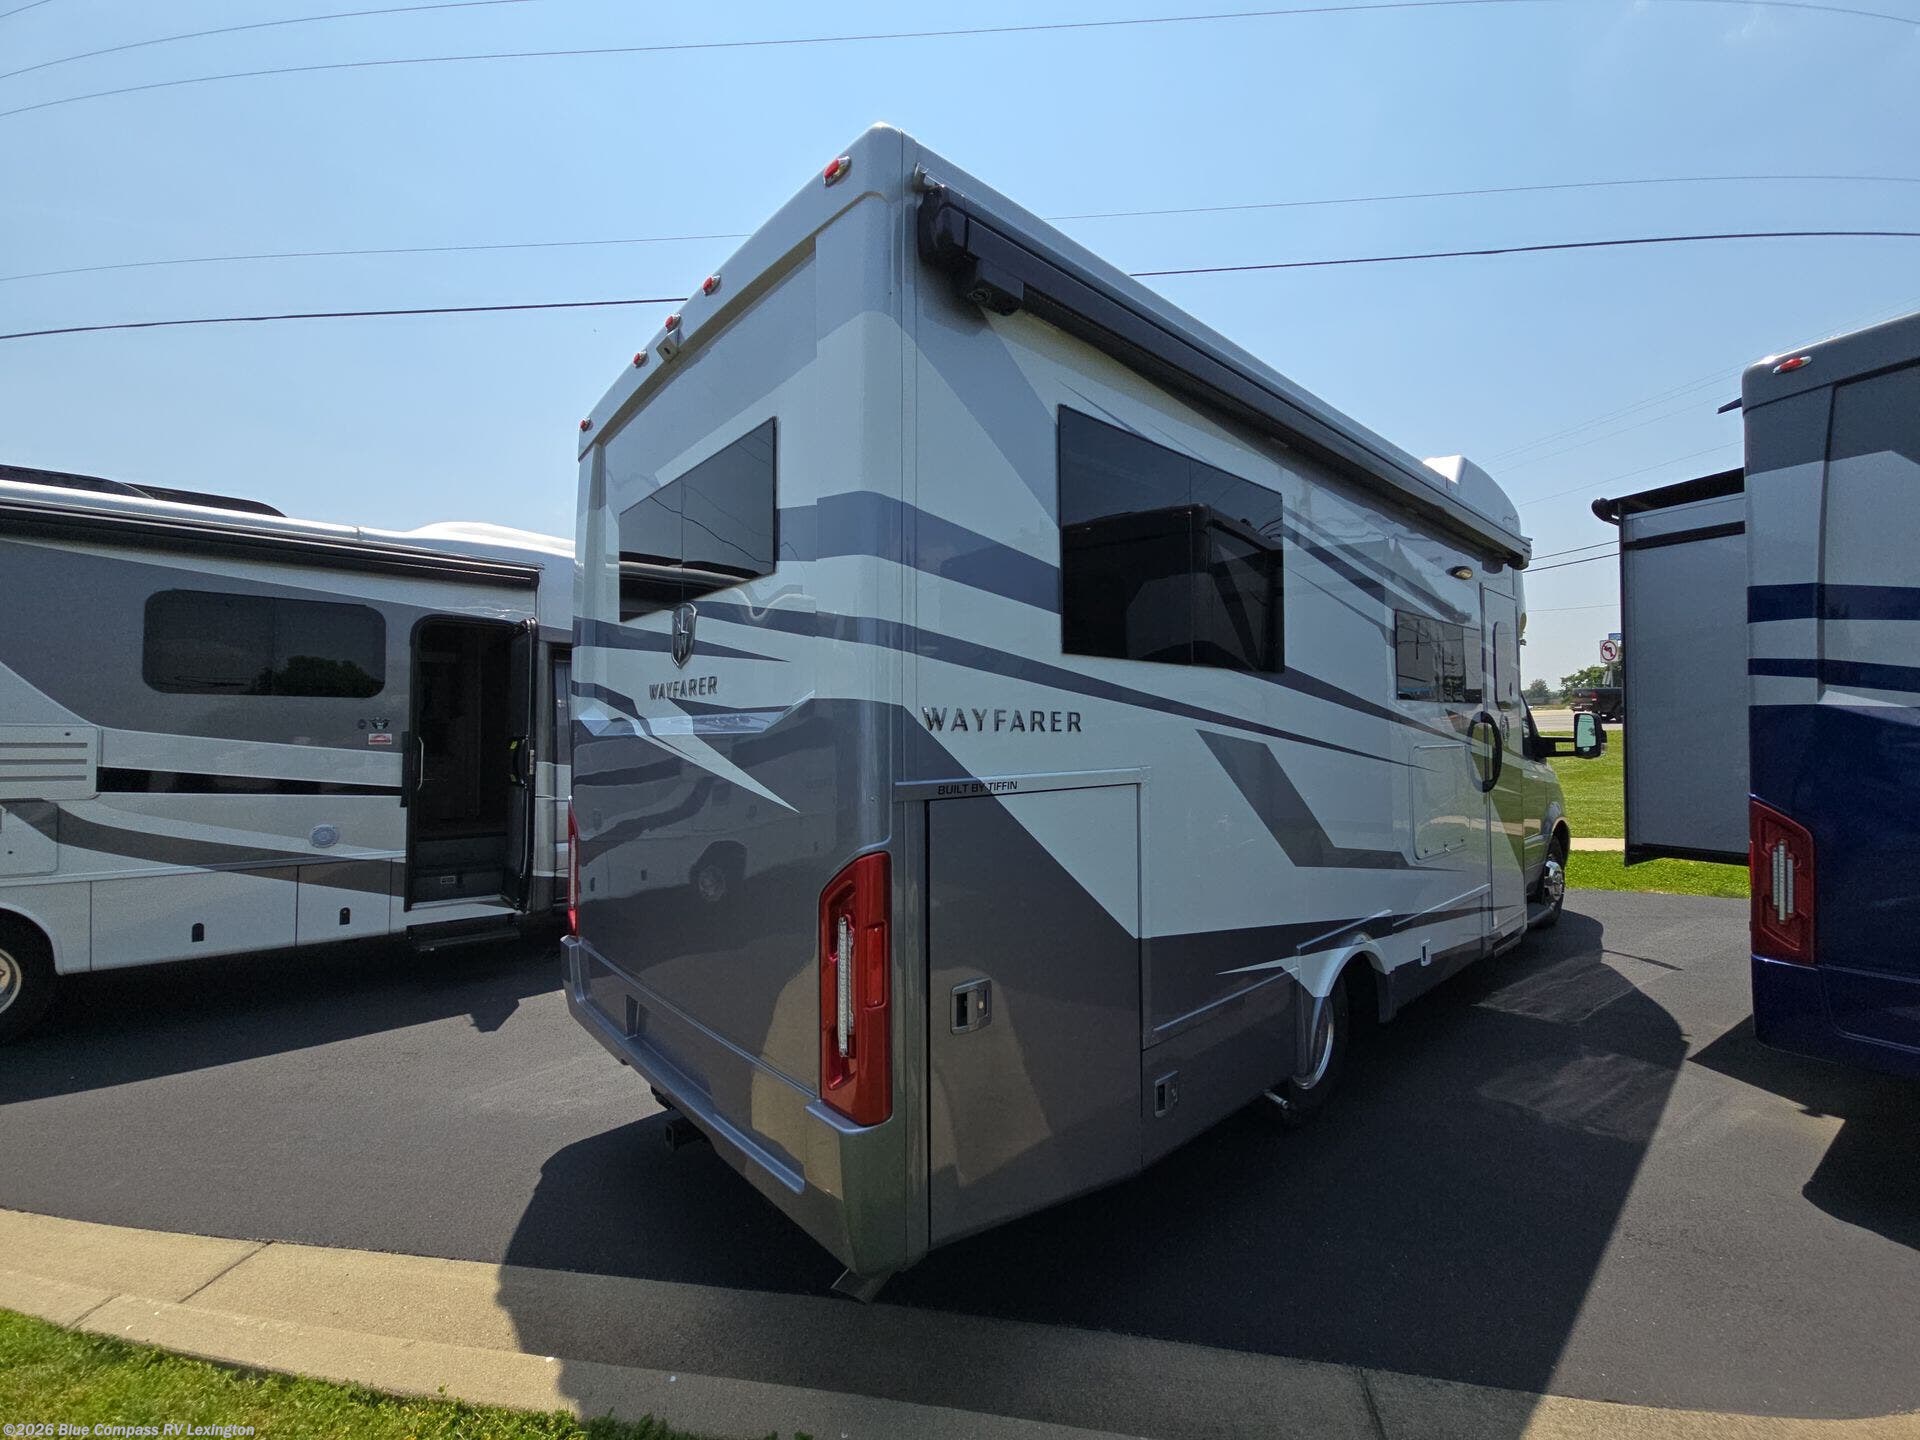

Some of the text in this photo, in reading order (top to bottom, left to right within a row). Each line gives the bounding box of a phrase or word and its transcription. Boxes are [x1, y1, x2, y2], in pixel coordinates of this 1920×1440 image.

[649, 676, 718, 700] WAYFARER
[921, 705, 1083, 733] WAYFARER
[937, 781, 1018, 795] BUILT BY TIFFIN
